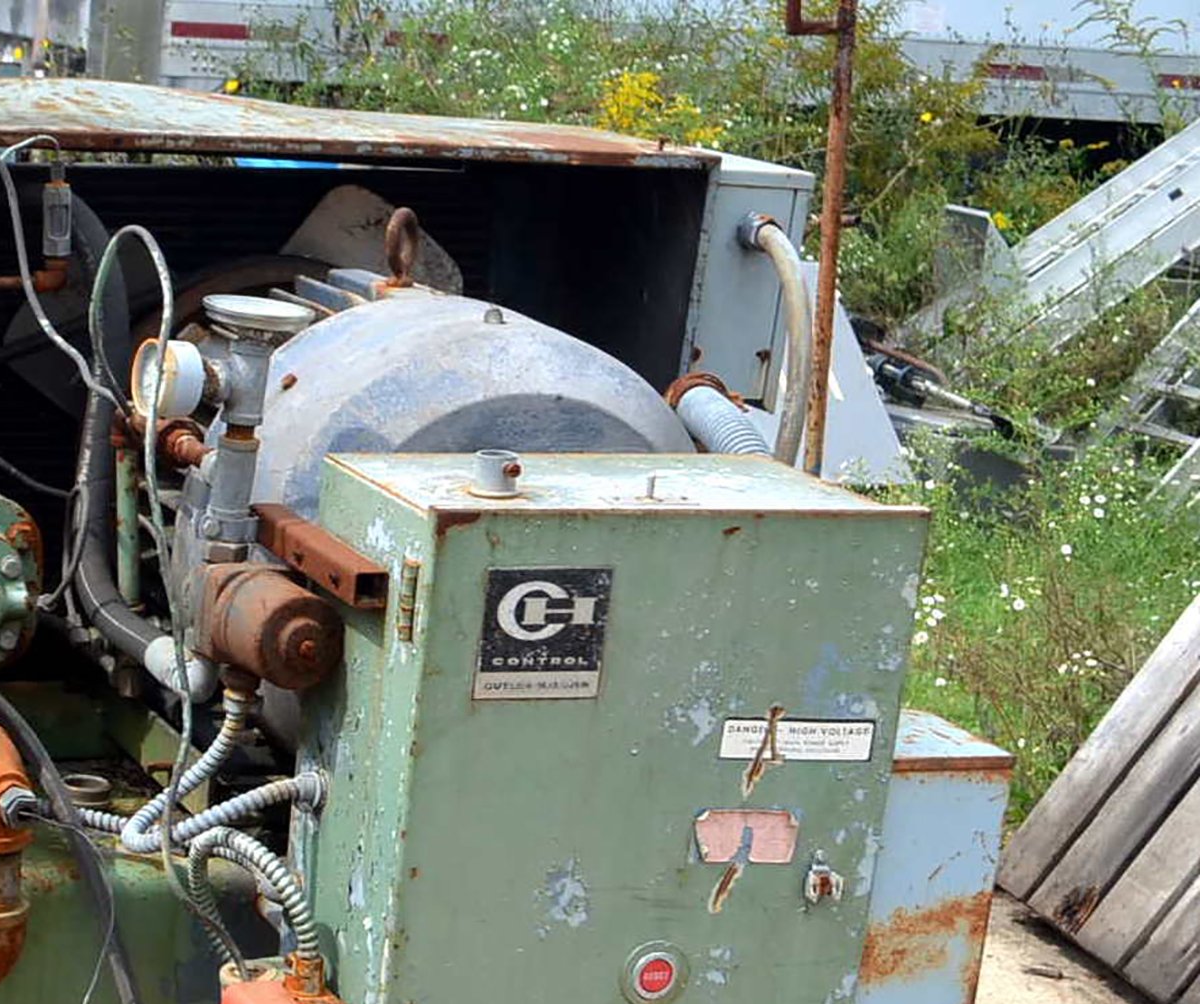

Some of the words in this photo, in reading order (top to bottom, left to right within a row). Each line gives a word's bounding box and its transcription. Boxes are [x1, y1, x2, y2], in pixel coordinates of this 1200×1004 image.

[491, 656, 589, 667] CONTROL
[788, 727, 817, 736] HIGH
[821, 726, 871, 738] VOLTAGE
